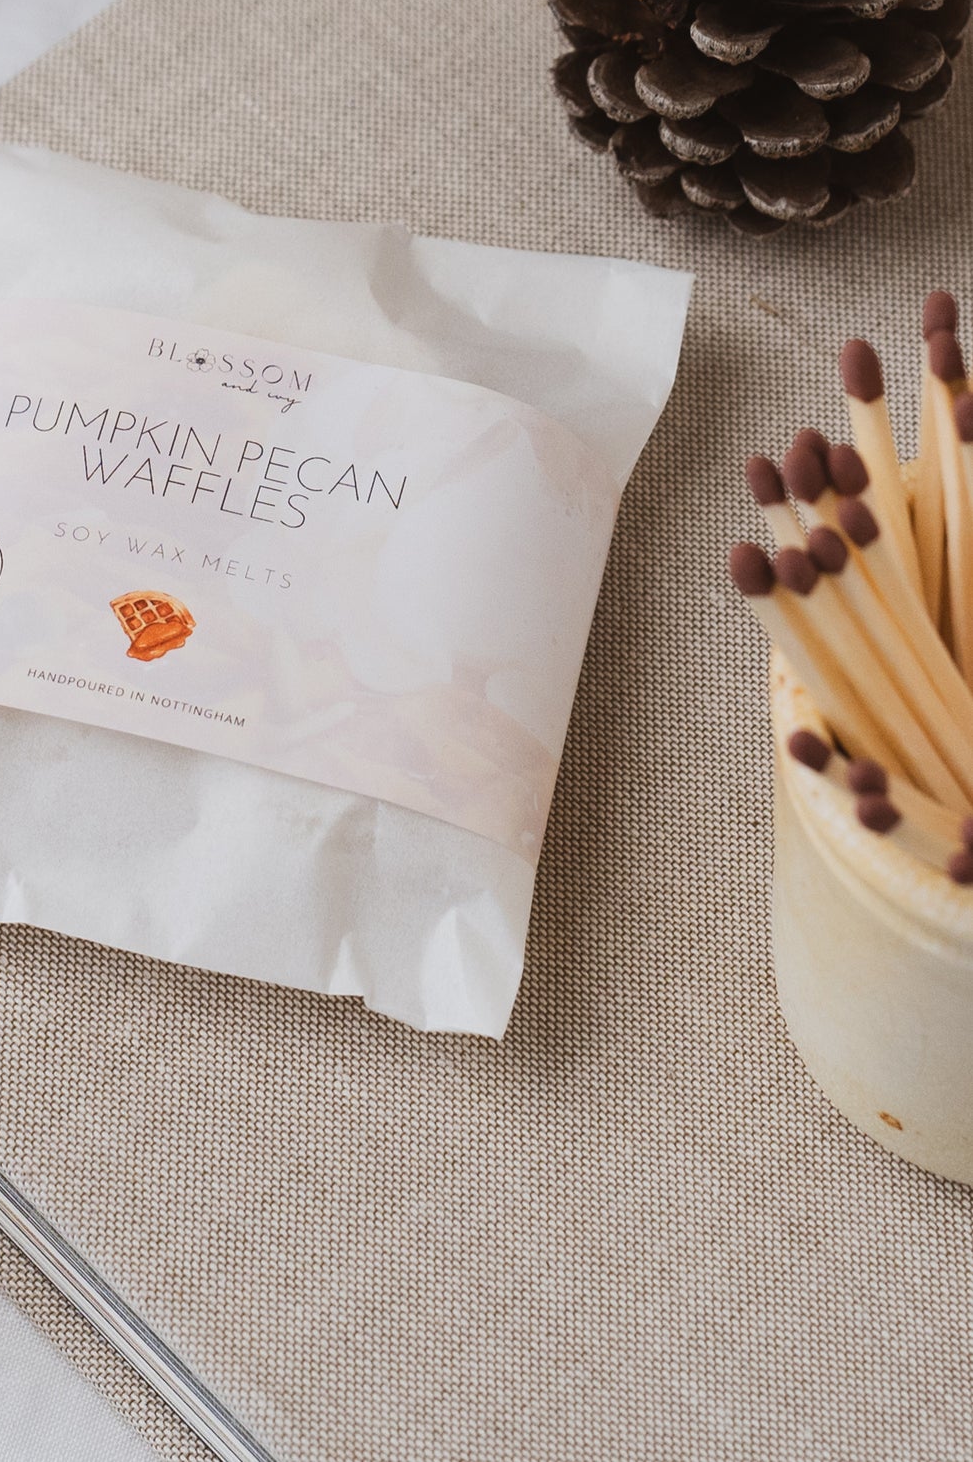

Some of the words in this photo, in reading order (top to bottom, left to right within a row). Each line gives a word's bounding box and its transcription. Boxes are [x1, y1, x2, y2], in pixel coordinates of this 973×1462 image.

[221, 380, 258, 394] and
[267, 392, 302, 413] ivy
[5, 395, 221, 466] PUMPKIN
[237, 440, 407, 509] PECAN
[83, 445, 310, 528] WAFFLES
[55, 522, 111, 545] SOY
[127, 537, 185, 563] WAX
[202, 555, 292, 589] MELTS
[27, 669, 125, 697] HANDPOURED
[130, 690, 146, 703] IN
[150, 694, 245, 727] NOTTINGHAM
